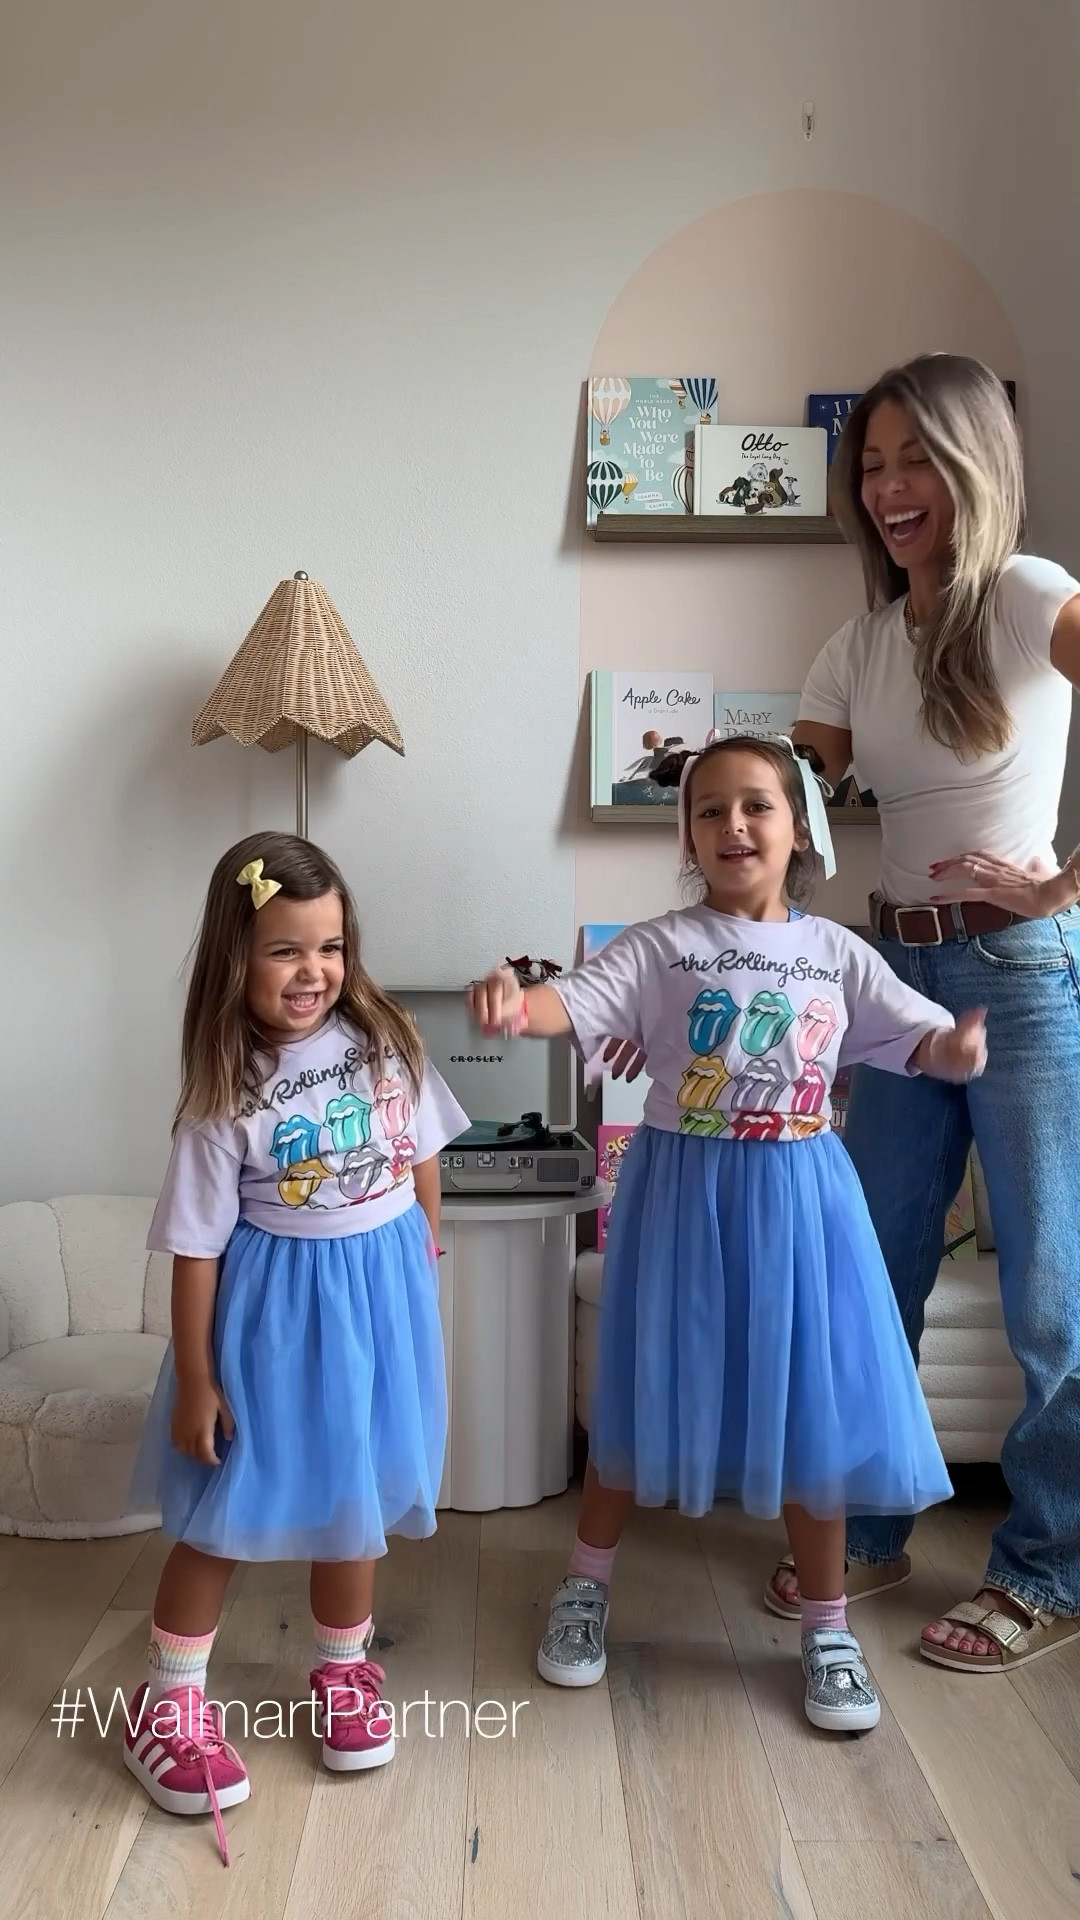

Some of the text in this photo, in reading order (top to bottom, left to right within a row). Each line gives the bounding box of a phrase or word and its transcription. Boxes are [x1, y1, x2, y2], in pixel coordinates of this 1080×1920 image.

[629, 416, 657, 429] You
[637, 406, 672, 423] Who
[640, 431, 679, 443] Were
[741, 432, 789, 452] Otto
[623, 442, 664, 459] Made
[640, 455, 655, 469] to
[645, 469, 664, 482] Be
[622, 687, 701, 709] Apple Cake
[723, 708, 773, 725] MARY
[669, 949, 844, 991] the Rolling Stone
[449, 1055, 504, 1063] CROSLEY
[269, 1063, 350, 1106] Rolling
